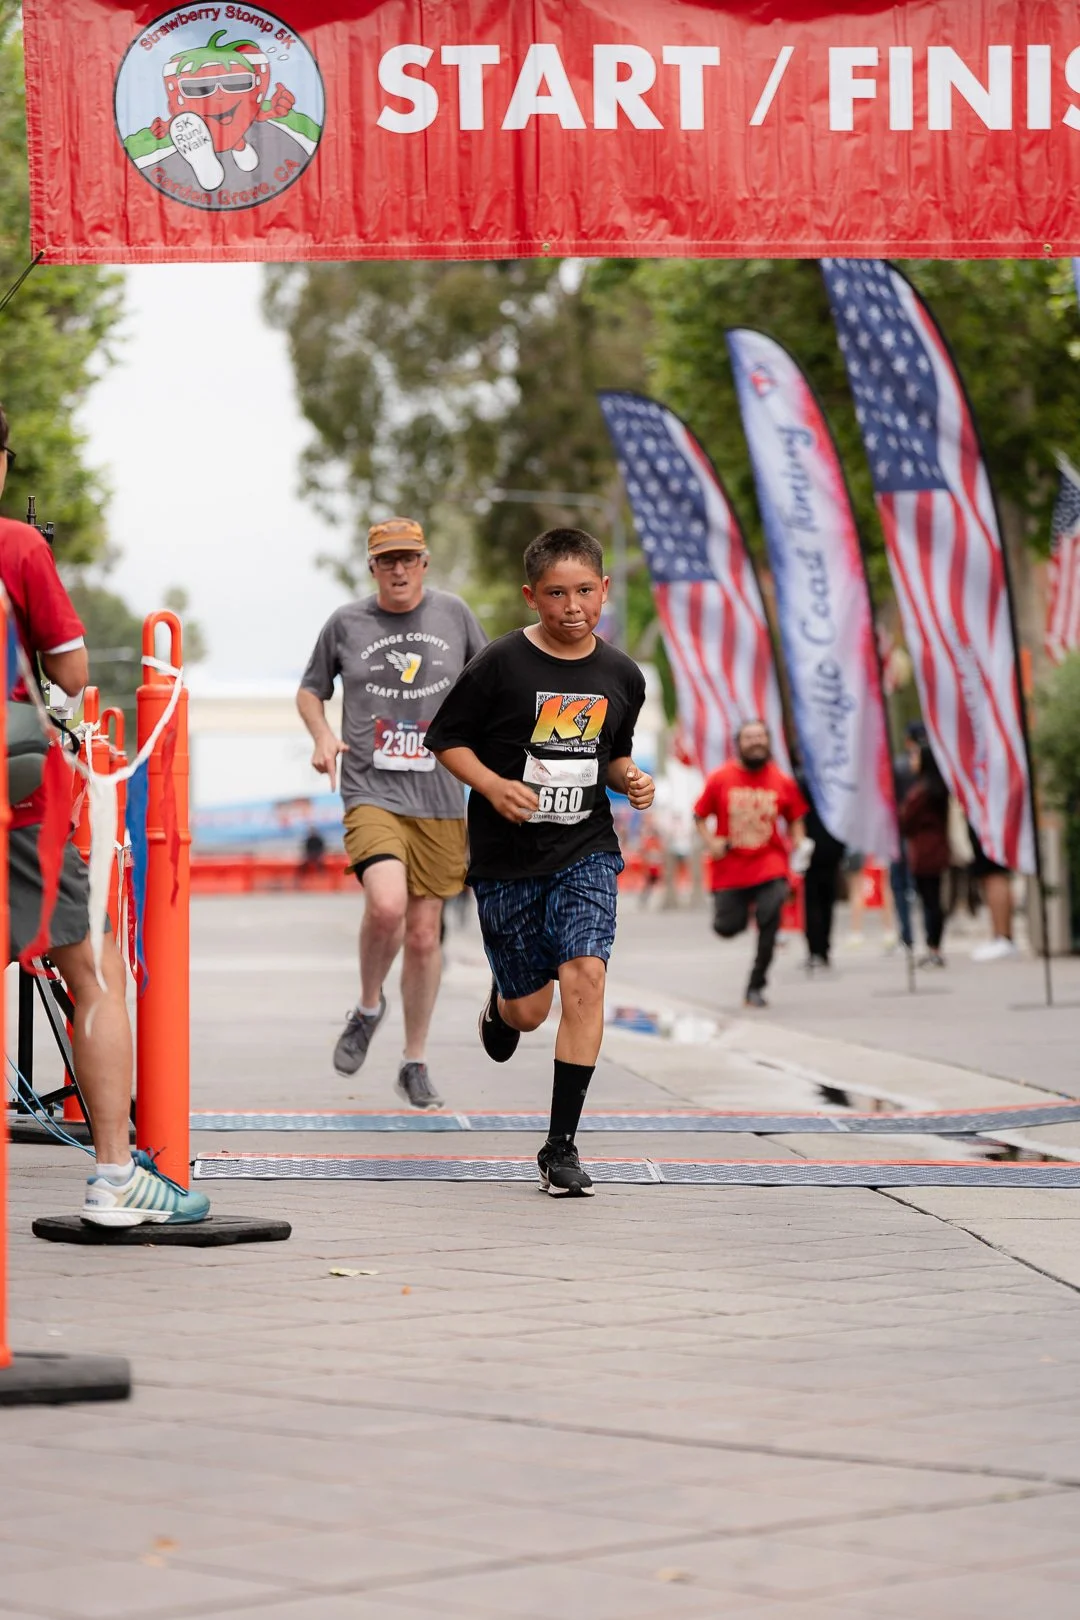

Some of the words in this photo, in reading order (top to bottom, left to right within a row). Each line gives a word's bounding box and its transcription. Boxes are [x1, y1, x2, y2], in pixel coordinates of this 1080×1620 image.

[139, 7, 221, 51] Strawberry
[225, 5, 274, 33] Stomp
[274, 28, 297, 50] 5K
[376, 43, 720, 134] START
[749, 46, 795, 126] /
[828, 44, 1080, 132] FINI
[175, 117, 194, 132] 5K
[178, 136, 211, 154] Walk
[150, 166, 213, 205] Garden
[273, 159, 301, 182] CA
[776, 423, 819, 533] Timing
[797, 547, 837, 646] Coast
[361, 633, 404, 660] ORANGE
[406, 632, 450, 651] COUNTY
[365, 682, 400, 699] CRAFT
[402, 677, 451, 700] RUNNERS
[530, 694, 609, 743] K1
[574, 746, 597, 754] SPEED
[539, 787, 584, 813] 660
